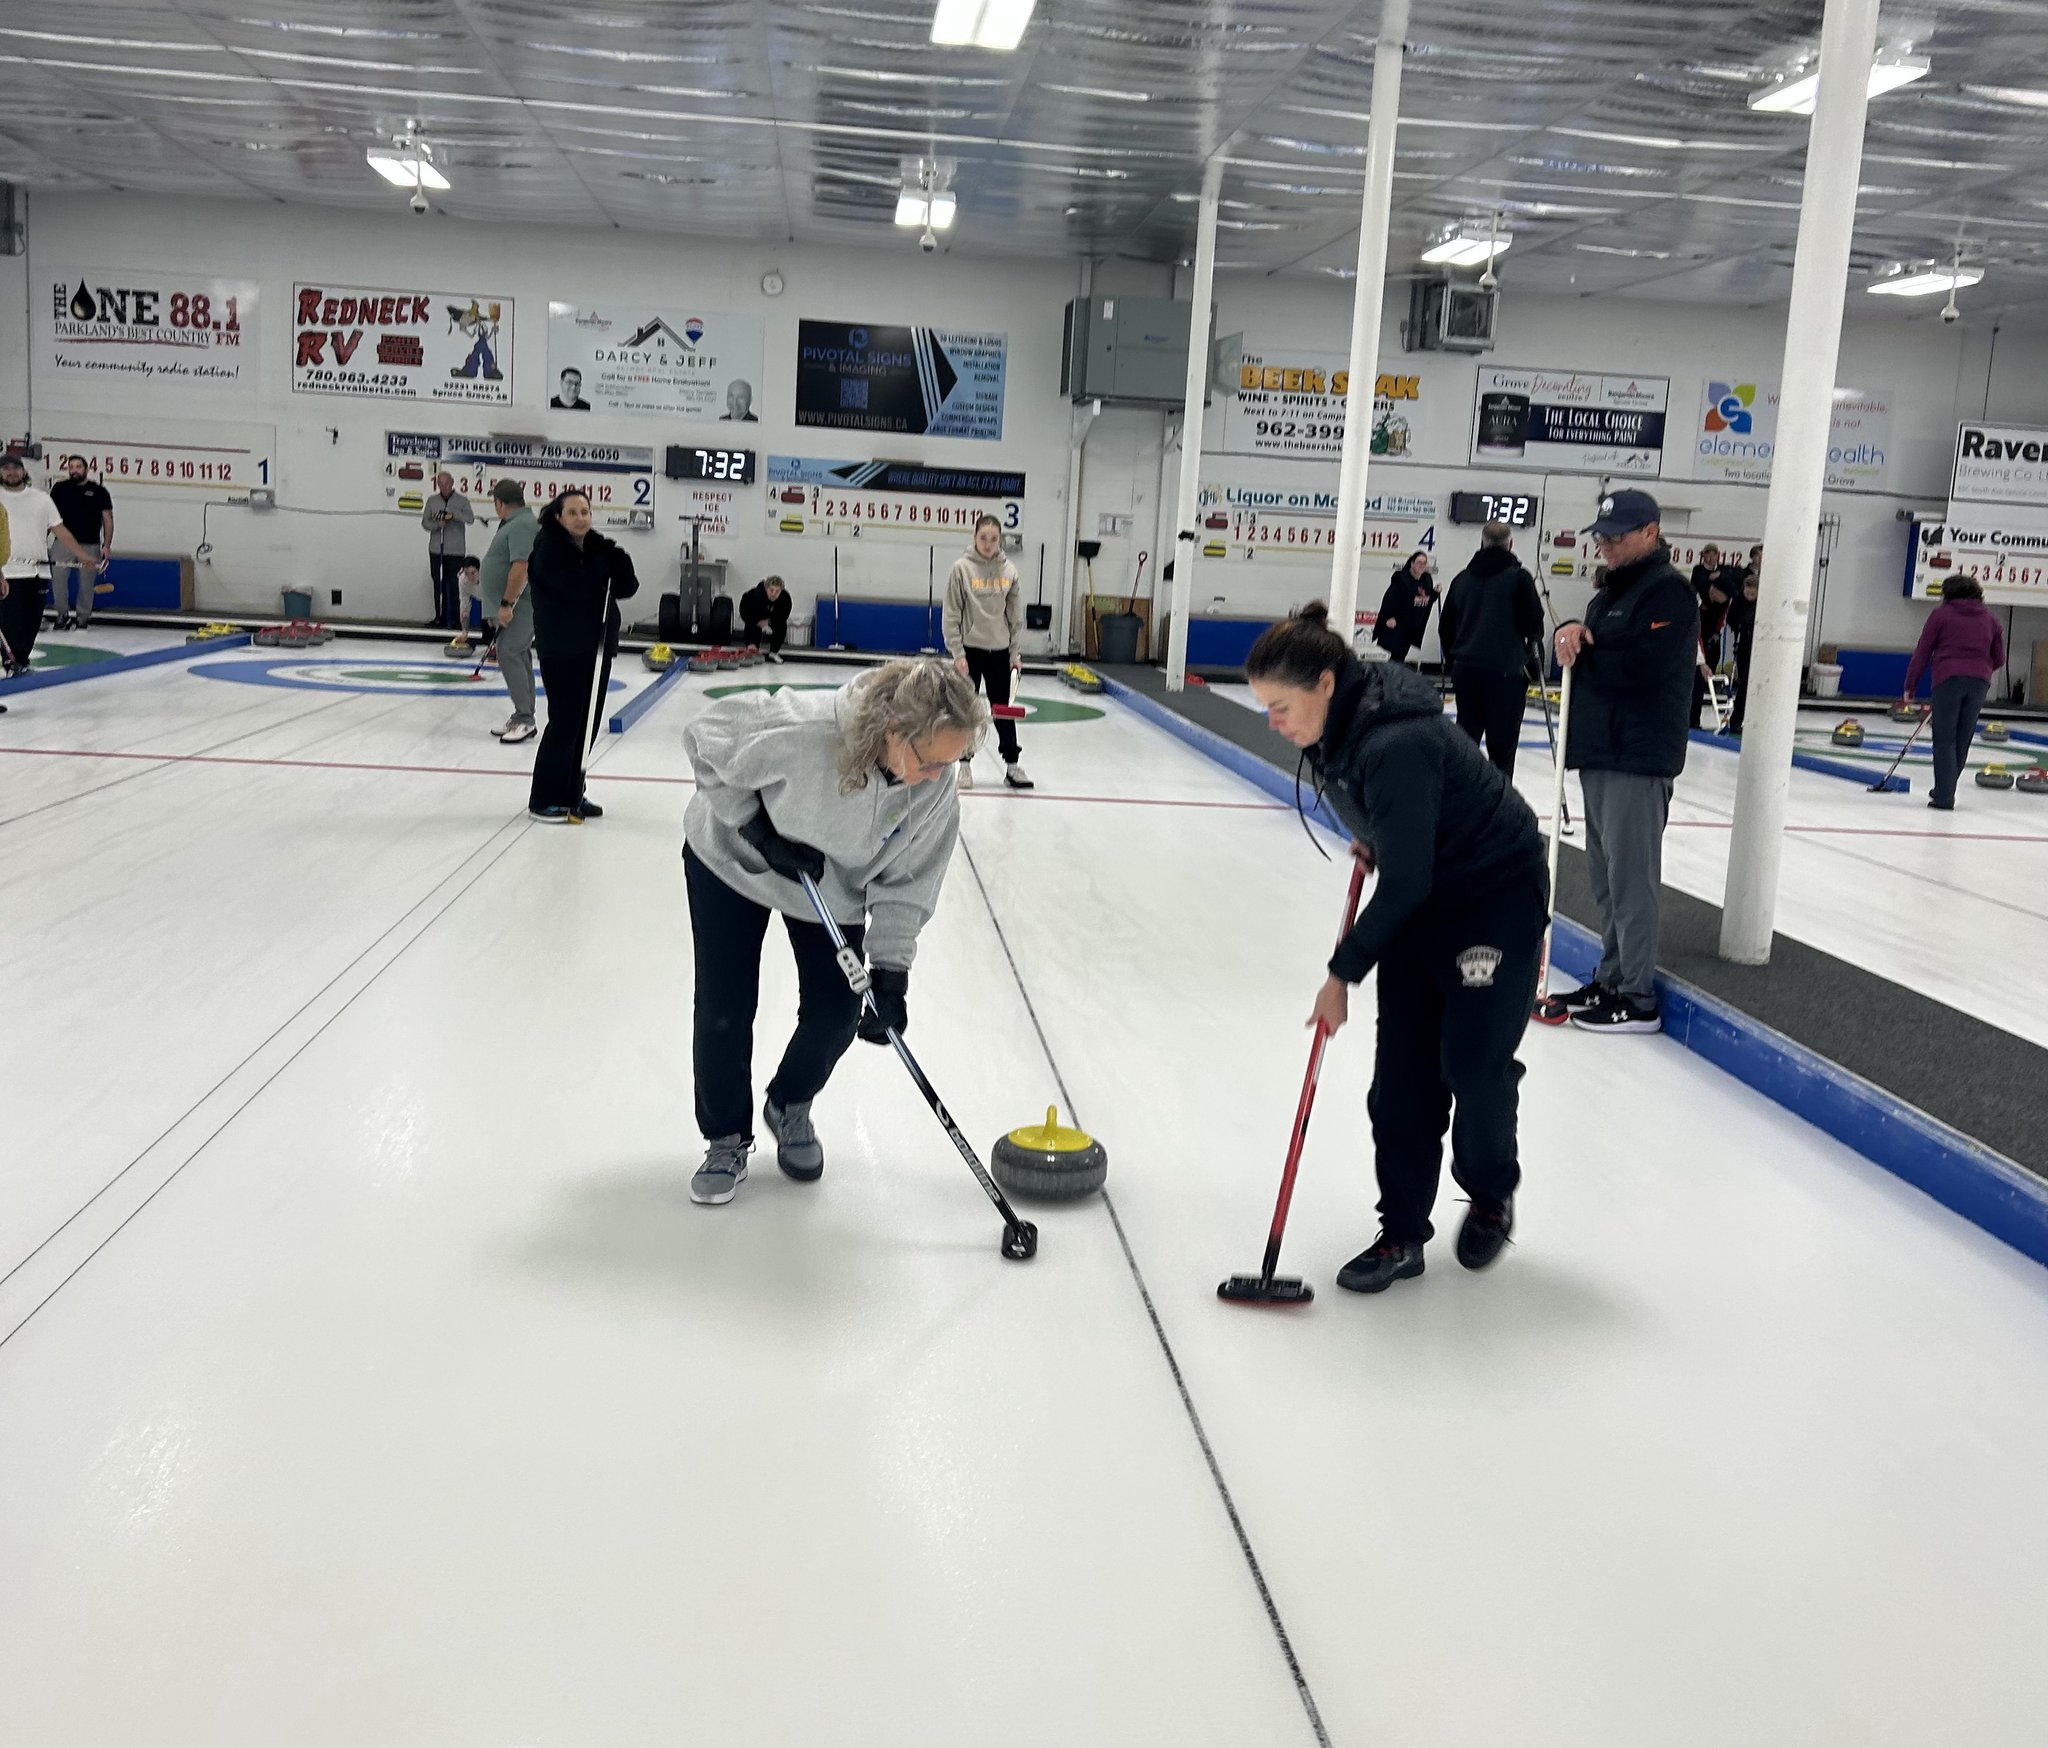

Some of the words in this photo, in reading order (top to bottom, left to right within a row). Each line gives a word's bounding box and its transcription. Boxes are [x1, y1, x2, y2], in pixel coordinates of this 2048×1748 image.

[54, 283, 67, 320] THE
[169, 292, 240, 331] 88.1
[297, 288, 431, 326] REDNECK
[54, 321, 125, 337] PARKLAND'S
[127, 327, 152, 339] BEST
[156, 329, 211, 344] COUNTRY
[215, 331, 240, 346] FM
[296, 329, 363, 367] RV
[803, 347, 863, 363] PIVOTAL
[867, 352, 912, 368] SIGNS
[55, 354, 82, 369] Your
[85, 359, 153, 378] community
[157, 362, 190, 375] radio
[193, 364, 240, 379] station!
[595, 350, 651, 364] DARCY
[660, 354, 667, 366] &
[676, 355, 717, 368] JEFF
[1241, 354, 1262, 364] The
[306, 369, 408, 387] 780.963.4233
[840, 364, 887, 376] IMAGING
[297, 381, 417, 397] redneckrvalberta.com
[1240, 366, 1326, 394] BEER
[1330, 371, 1420, 400] SAK
[1238, 392, 1269, 403] WINE
[1282, 395, 1327, 407] SPIRITS
[1243, 406, 1265, 416] Next
[1269, 408, 1278, 416] to
[1545, 406, 1564, 426] THE
[1568, 408, 1600, 428] LOCAL
[1605, 410, 1643, 431] CHOICE
[1256, 420, 1344, 440] 962-399
[1548, 426, 1564, 440] FOR
[1566, 428, 1611, 442] EVERYTHING
[1614, 430, 1637, 445] PAINT
[391, 434, 438, 448] Travelodge
[448, 438, 492, 453] SPRUCE
[494, 442, 532, 455] GROVE
[541, 444, 620, 461] 780-962-6050
[1255, 439, 1342, 452] www.thebeershak
[1700, 434, 1775, 458] eleme
[1829, 443, 1885, 464] ealth
[43, 453, 50, 470] 1
[59, 454, 69, 471] 2
[89, 456, 97, 472] 4
[105, 456, 113, 473] 5
[120, 457, 128, 474] 6
[135, 459, 143, 475] 7
[151, 459, 159, 476] 8
[166, 460, 174, 478] 9
[180, 461, 194, 479] 10
[199, 462, 212, 480] 11
[217, 463, 231, 481] 12
[258, 457, 269, 485] 1
[385, 462, 392, 475] 4
[475, 464, 484, 477] 2
[695, 450, 745, 479] 7:32
[768, 468, 799, 477] PIVOTAL
[1959, 464, 2010, 482] Brewing
[2015, 468, 2031, 481] Co
[1724, 468, 1740, 478] Two
[1743, 469, 1772, 479] locatio
[1828, 474, 1855, 486] Grove
[460, 477, 469, 493] 3
[475, 478, 483, 494] 4
[534, 481, 541, 497] 8
[549, 482, 557, 498] 9
[598, 485, 611, 502] 12
[633, 478, 650, 506] 2
[692, 491, 732, 502] RESPECT
[770, 486, 776, 499] 4
[1226, 488, 1283, 507] Liquor
[1288, 494, 1310, 506] on
[1313, 492, 1382, 510] Mcod
[704, 503, 719, 512] ICE
[811, 499, 817, 515] 1
[826, 500, 834, 516] 2
[840, 501, 847, 517] 3
[853, 502, 861, 518] 4
[867, 502, 875, 519] 5
[880, 503, 888, 520] 6
[894, 504, 902, 520] 7
[910, 505, 917, 521] 8
[924, 506, 931, 522] 9
[937, 507, 949, 524] 10
[955, 508, 967, 525] 11
[1003, 502, 1019, 529] 3
[1482, 496, 1528, 524] 7:32
[853, 525, 860, 537] 2
[1247, 526, 1255, 541] 2
[1261, 526, 1268, 542] 3
[1273, 527, 1281, 542] 4
[1288, 527, 1295, 543] 5
[1301, 527, 1309, 544] 6
[1314, 528, 1321, 544] 7
[1328, 529, 1335, 545] 8
[1371, 532, 1383, 548] 11
[1387, 532, 1399, 549] 12
[1418, 525, 1435, 552] 4
[1950, 527, 1987, 544] Your
[1990, 530, 2048, 548] Commu
[1247, 547, 1253, 559] 2
[1673, 547, 1680, 563] 8
[1686, 548, 1693, 564] 9
[1983, 565, 1990, 581] 3
[1995, 566, 2003, 582] 4
[2009, 566, 2016, 583] 5
[2021, 567, 2029, 584] 6
[2035, 568, 2042, 584] 7
